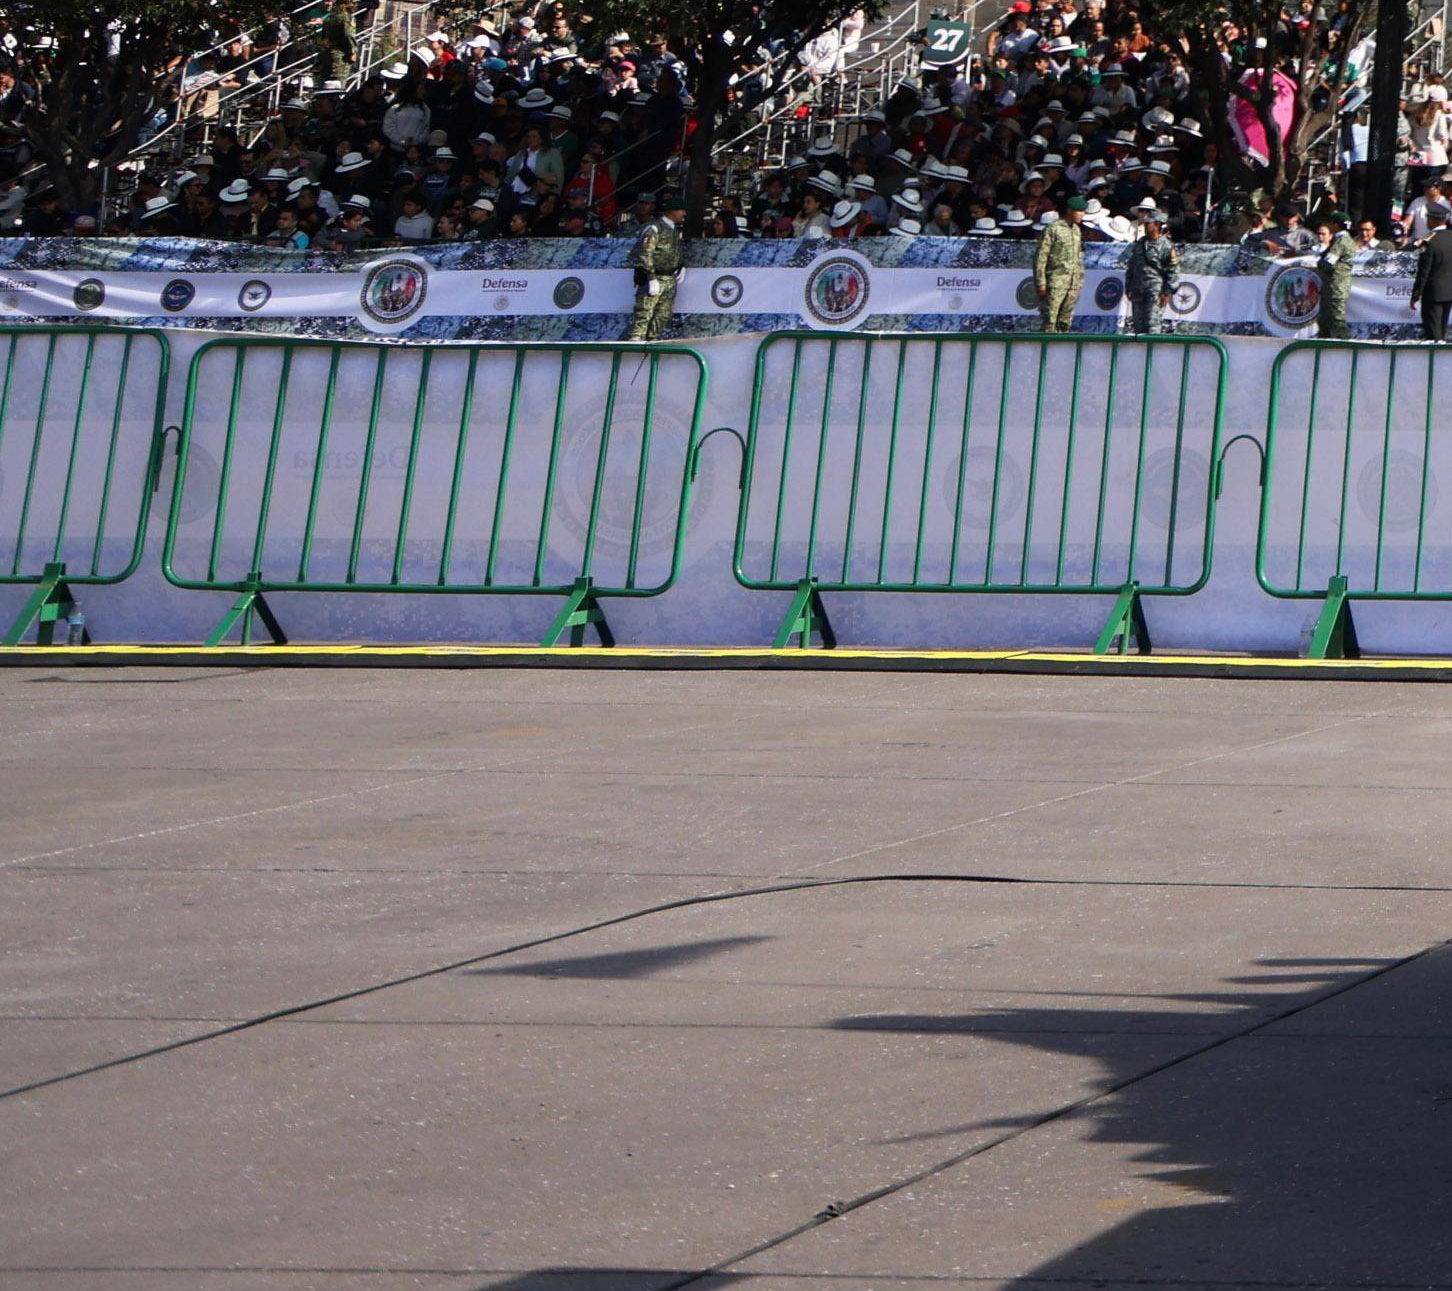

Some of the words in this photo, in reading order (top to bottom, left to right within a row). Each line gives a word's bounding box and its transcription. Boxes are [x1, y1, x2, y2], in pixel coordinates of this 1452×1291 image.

[931, 29, 964, 51] 27
[0, 277, 37, 288] efensa
[482, 277, 528, 289] Defensa
[936, 275, 981, 288] Defensa
[1386, 285, 1412, 297] Defe
